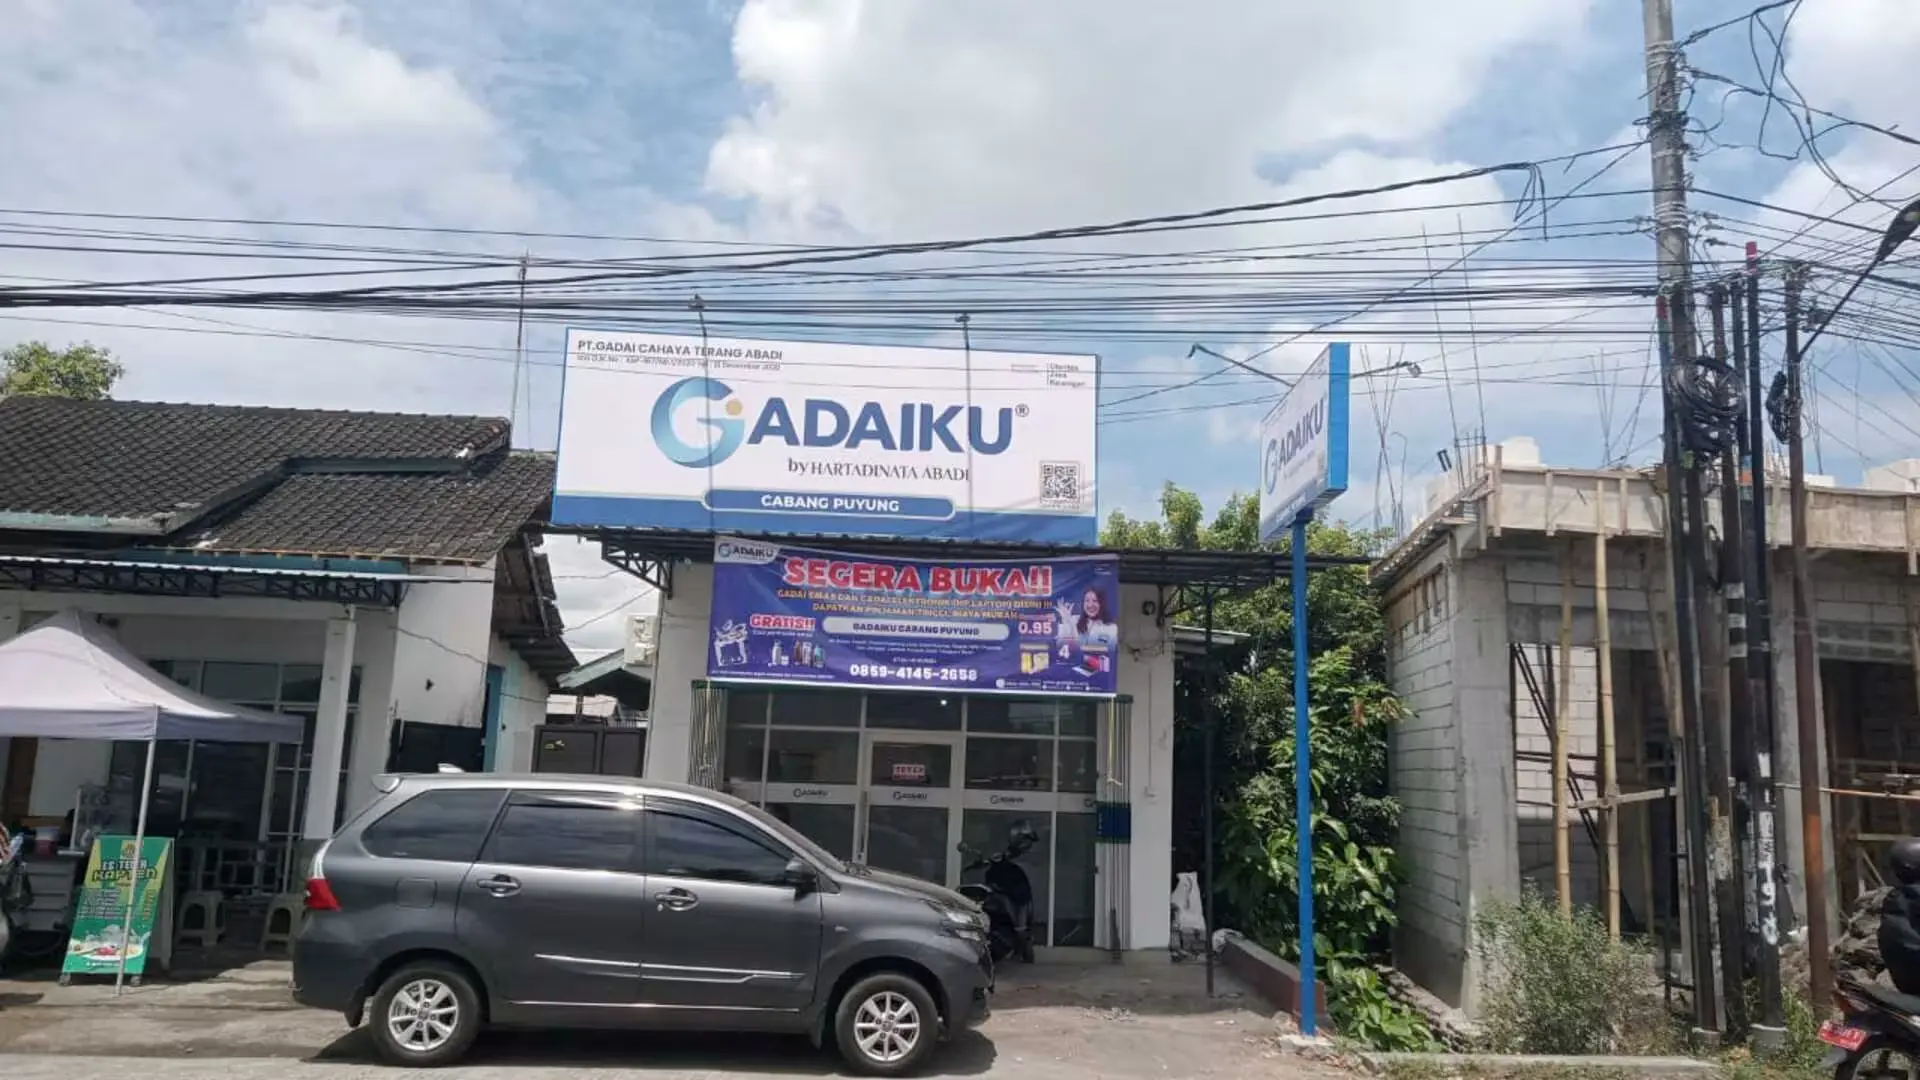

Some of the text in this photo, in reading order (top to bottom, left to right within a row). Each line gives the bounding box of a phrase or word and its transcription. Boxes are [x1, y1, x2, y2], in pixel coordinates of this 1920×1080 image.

[577, 340, 783, 361] PT.GADAI CAHAYA TERANG ABADI
[788, 458, 970, 482] by HARTADINATA ABADI
[761, 493, 900, 513] CABANG PUYUNG
[783, 556, 1053, 596] SEGERA BUKA!!
[1018, 622, 1052, 635] 0.95
